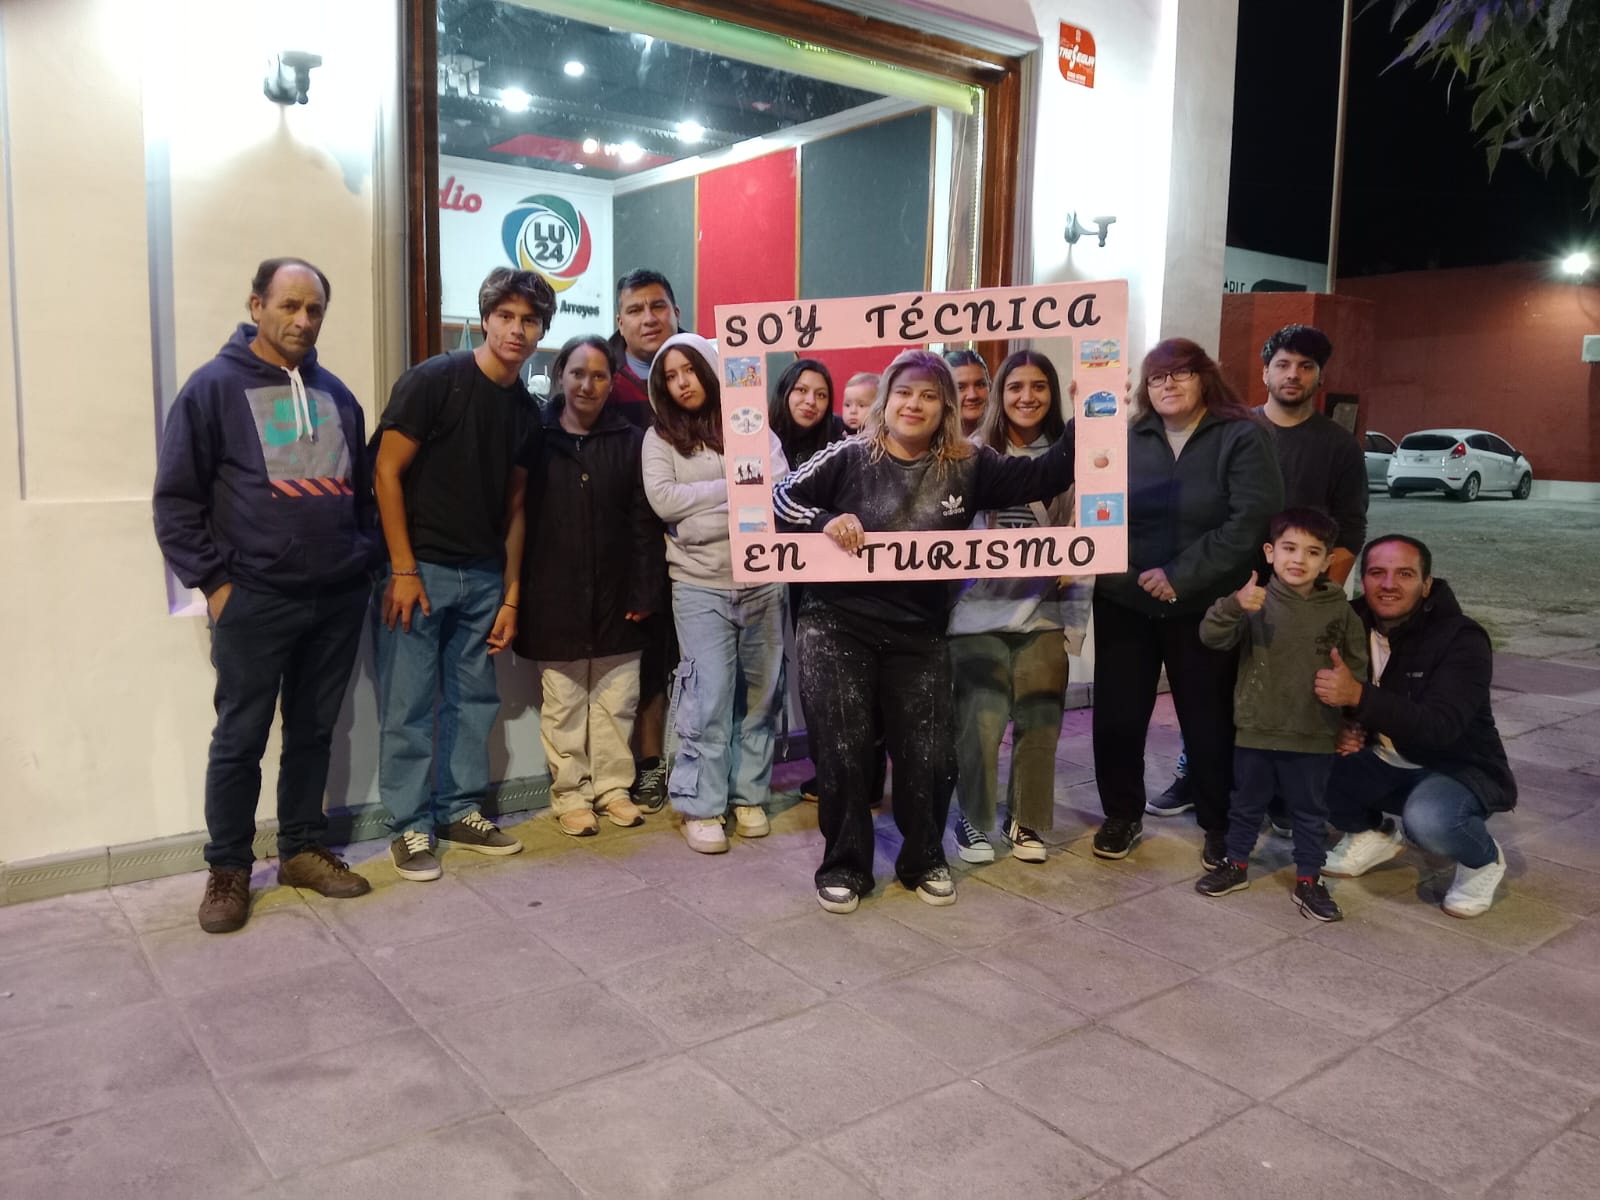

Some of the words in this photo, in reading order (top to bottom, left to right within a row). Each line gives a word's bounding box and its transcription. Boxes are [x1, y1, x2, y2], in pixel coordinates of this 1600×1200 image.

[534, 221, 565, 243] LU
[534, 242, 564, 263] 24
[560, 299, 600, 318] Arroyos
[725, 304, 822, 348] SOY
[743, 541, 806, 572] EN
[857, 535, 1096, 574] TURISMO
